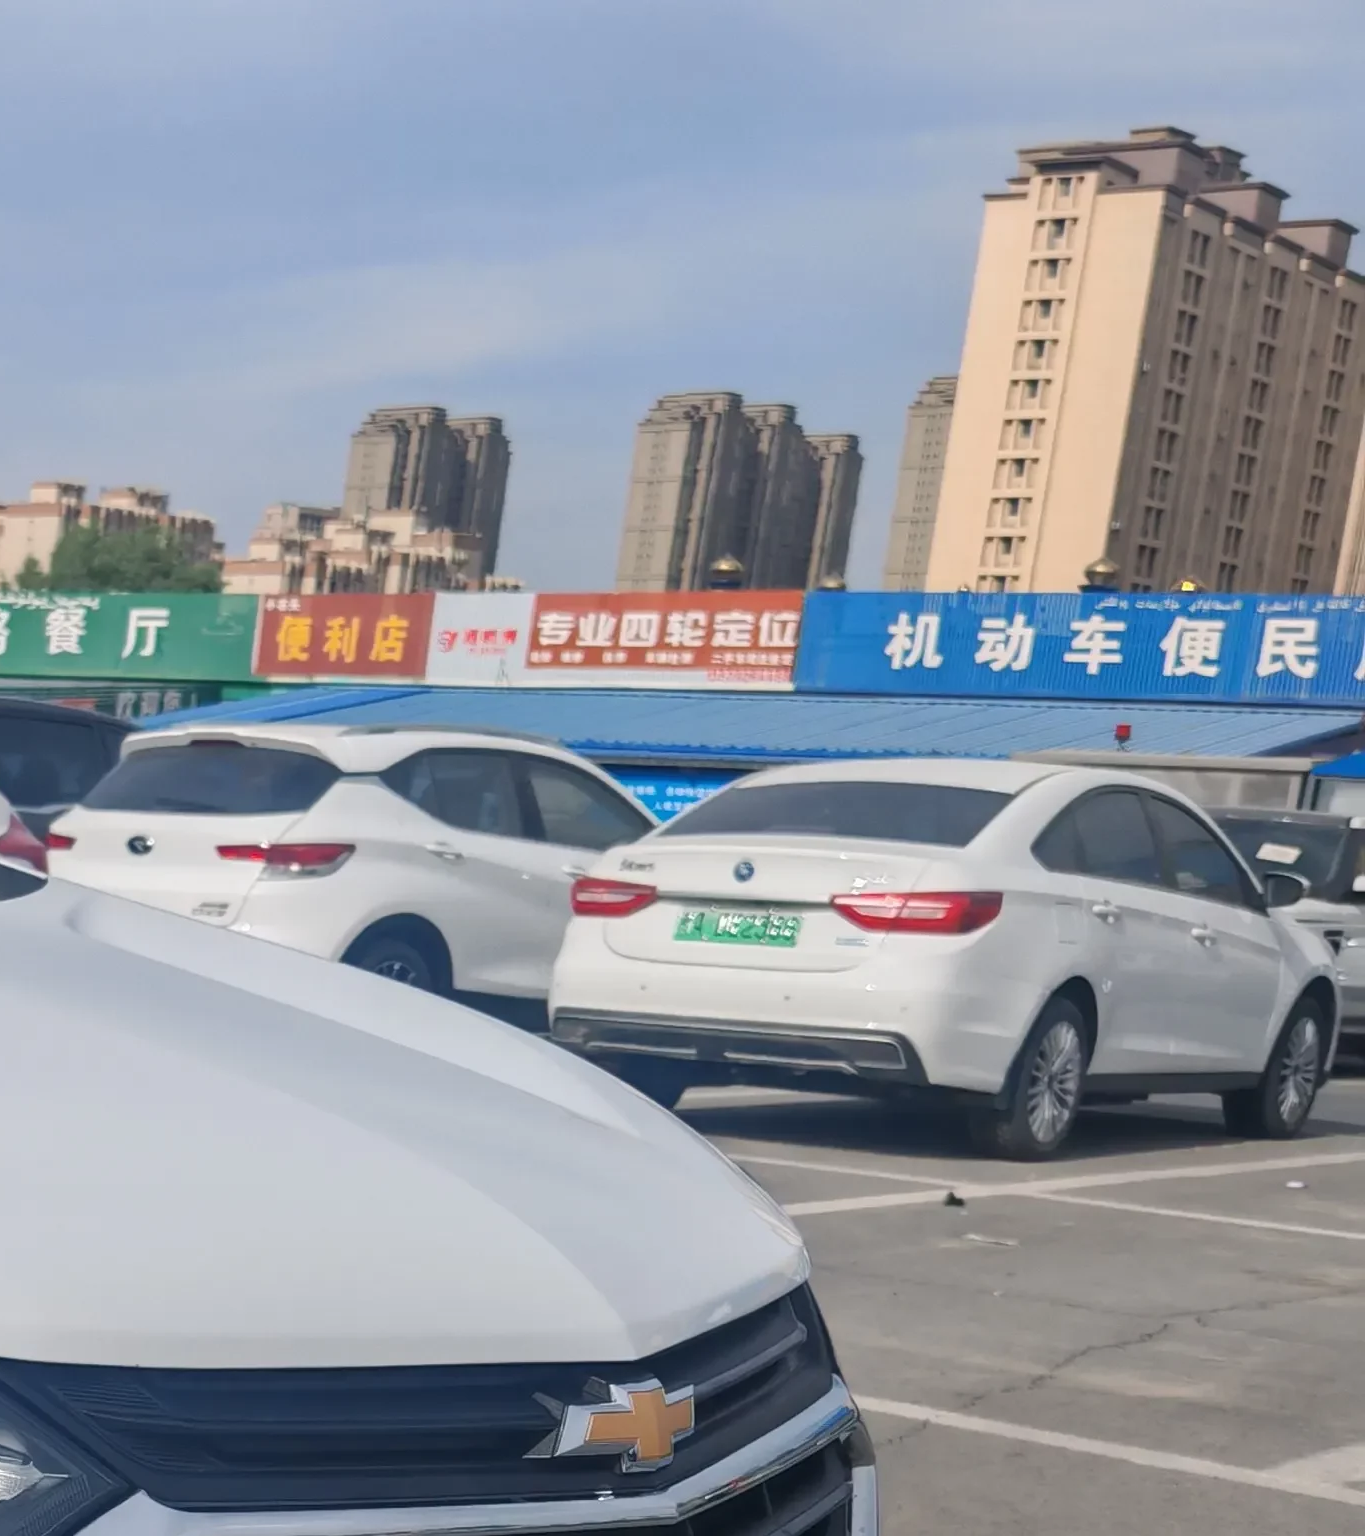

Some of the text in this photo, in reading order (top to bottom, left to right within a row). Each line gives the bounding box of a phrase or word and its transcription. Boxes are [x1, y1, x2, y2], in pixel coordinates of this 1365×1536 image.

[276, 614, 410, 664] 便利店
[537, 610, 801, 648] 专业四轮定位
[883, 610, 1365, 681] 机动车便民
